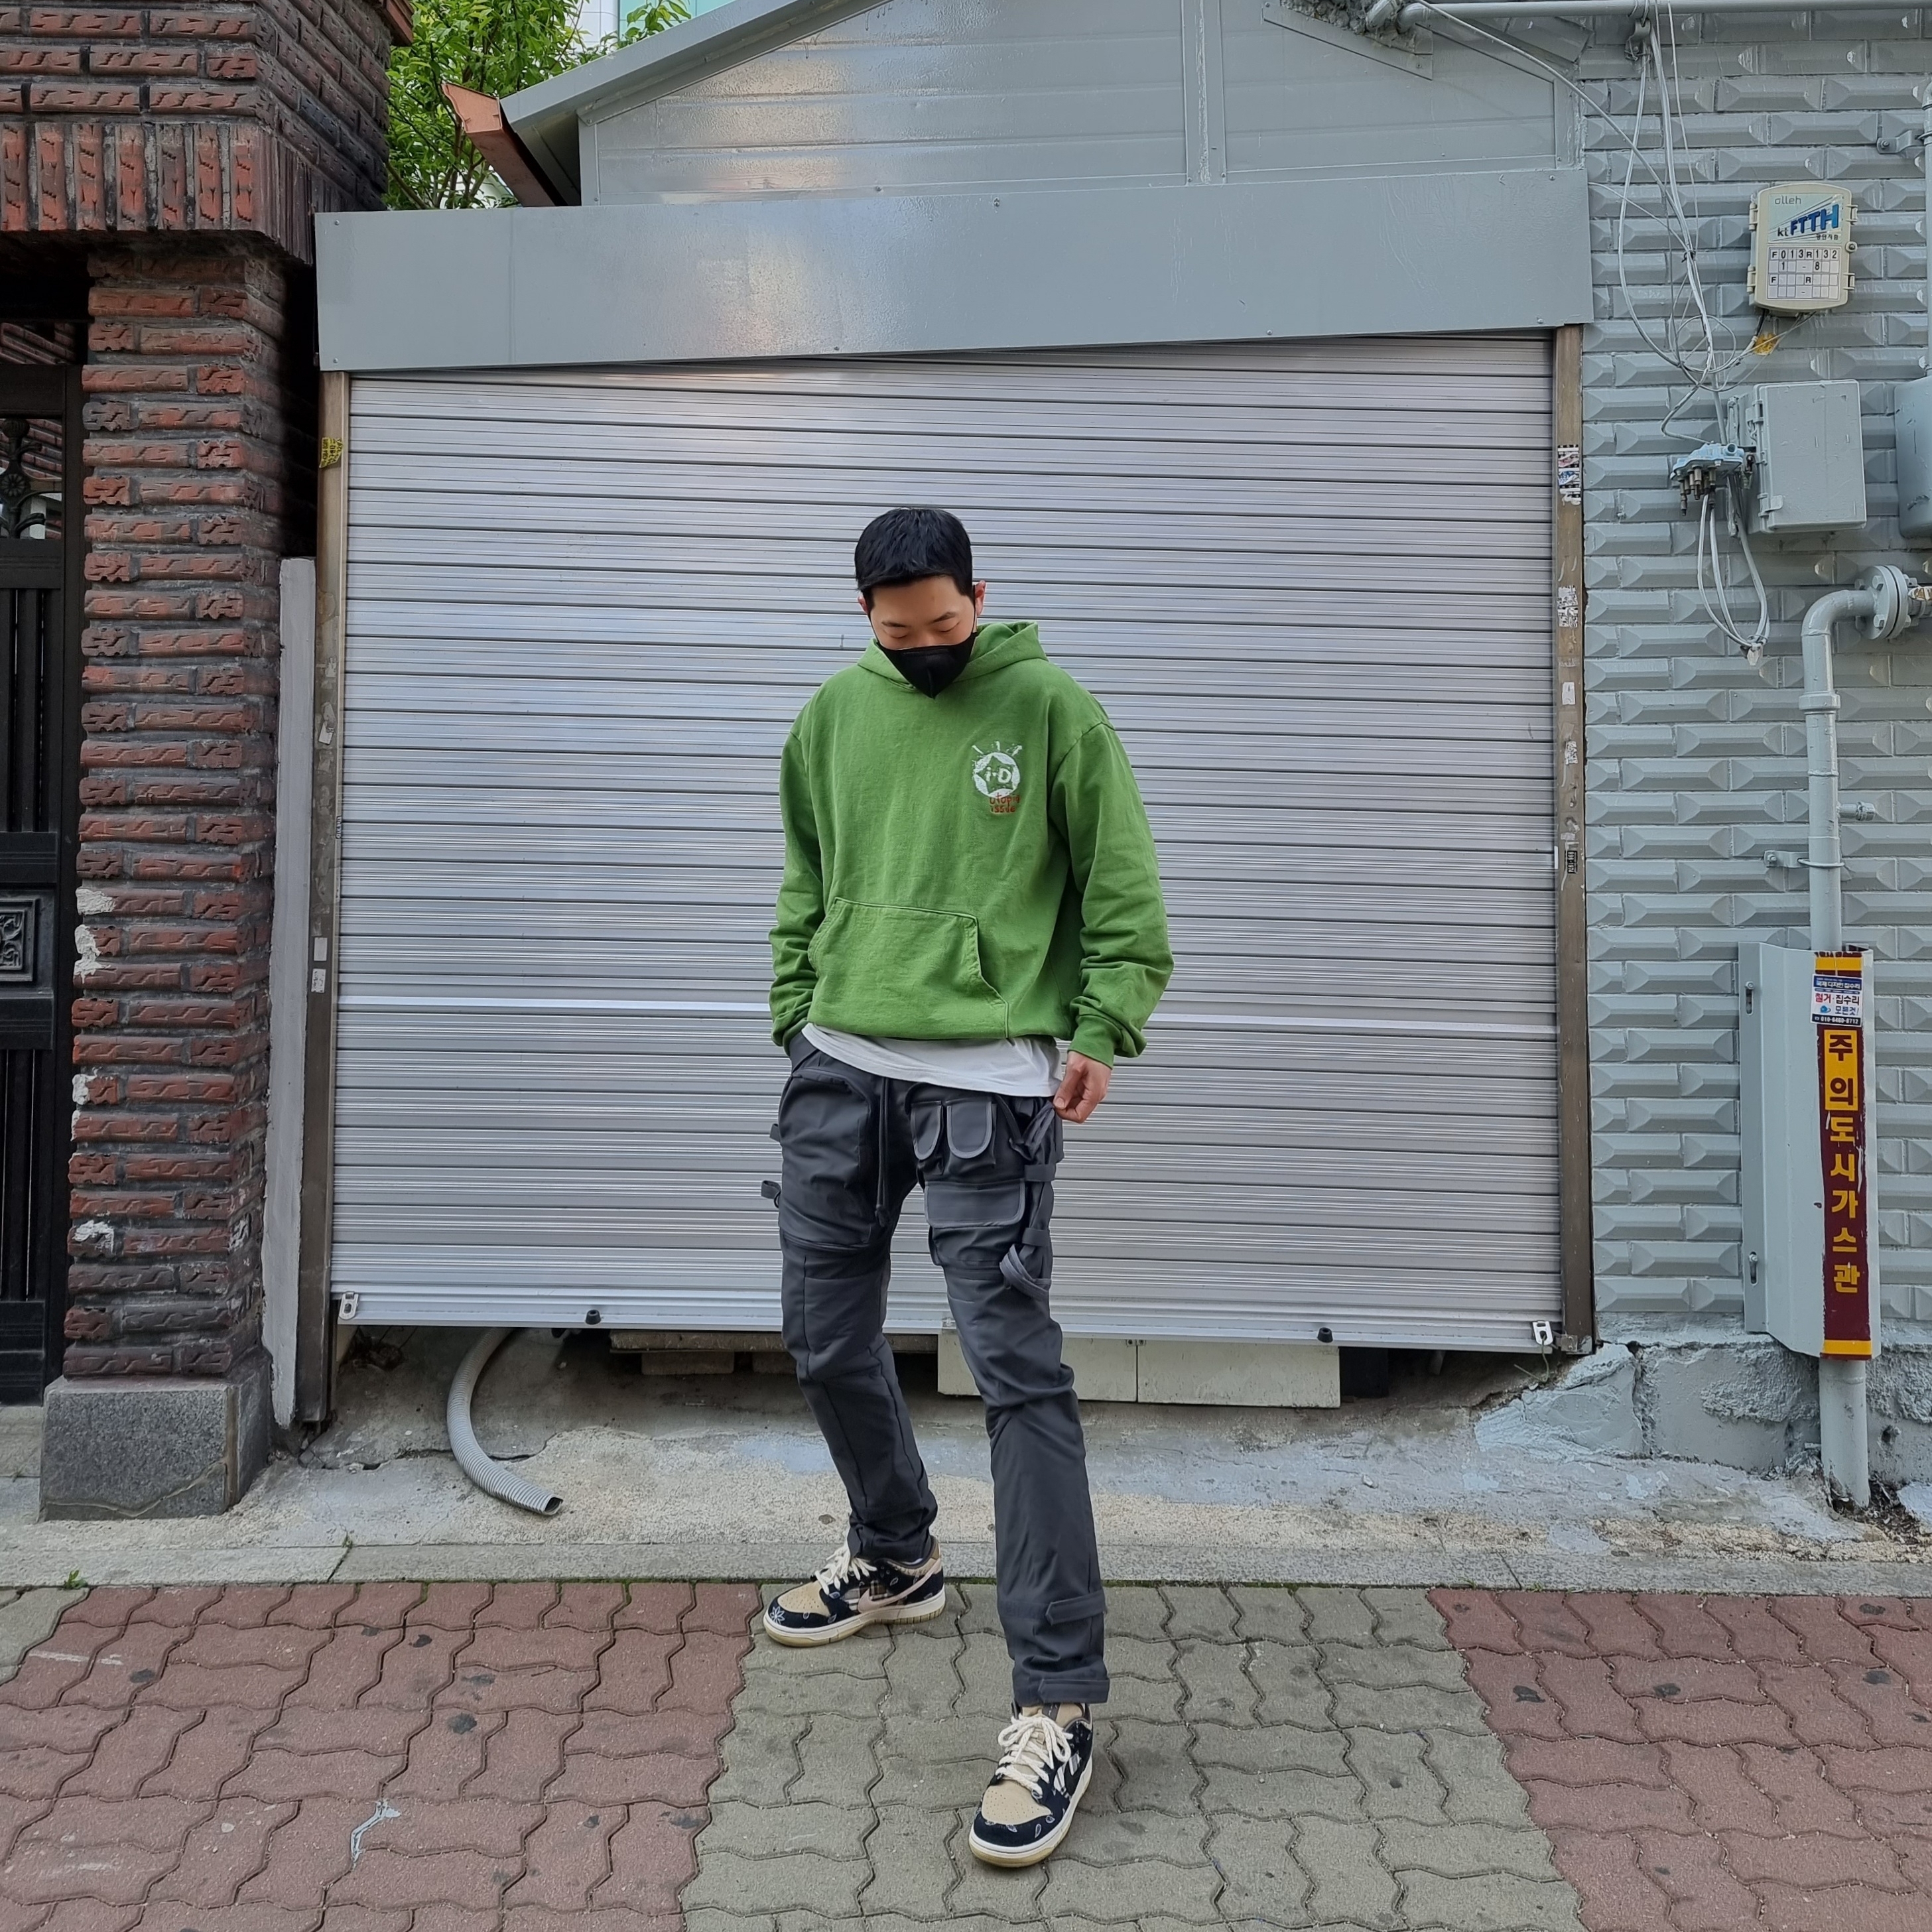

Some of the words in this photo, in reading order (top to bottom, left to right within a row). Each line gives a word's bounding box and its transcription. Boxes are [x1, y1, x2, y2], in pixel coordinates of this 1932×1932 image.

[1774, 196, 1801, 205] olleh
[1777, 227, 1789, 237] kt
[1790, 204, 1839, 235] FTTH
[1836, 994, 1860, 1005] 집수리
[1829, 1035, 1854, 1106] 주의
[1830, 1117, 1860, 1293] 도시가스관
